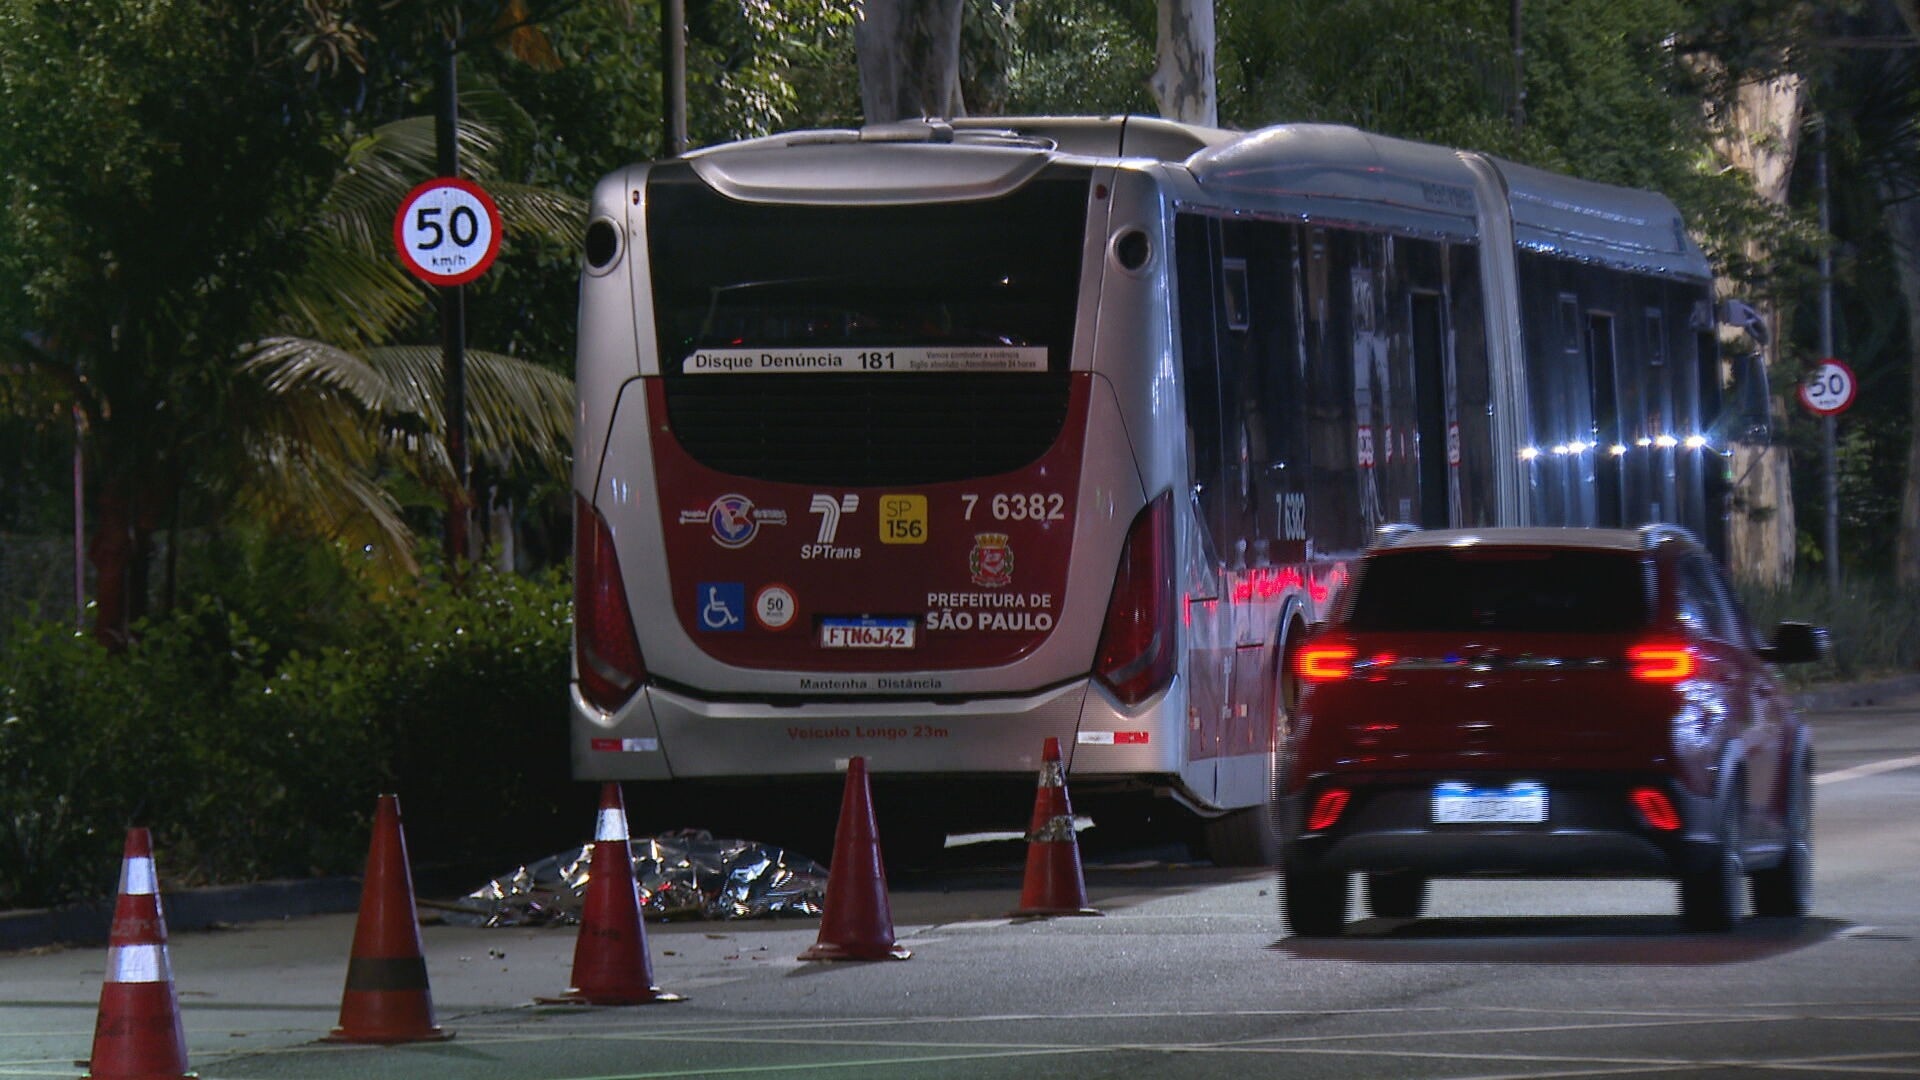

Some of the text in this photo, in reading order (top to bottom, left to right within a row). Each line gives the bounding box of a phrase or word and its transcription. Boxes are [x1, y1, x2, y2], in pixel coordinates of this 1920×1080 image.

[416, 205, 479, 250] 50
[431, 254, 467, 267] km/h
[695, 352, 895, 370] Disque Denúncia 181
[1811, 373, 1844, 397] 50
[886, 500, 912, 517] SP
[961, 493, 1065, 520] 7 6382
[886, 519, 922, 539] 156
[800, 544, 862, 559] SPTrans
[767, 598, 784, 611] 50
[927, 593, 1052, 608] PREFEITURA DE
[926, 608, 1054, 631] SÃO PAULO
[829, 627, 906, 645] FTN6J42
[800, 677, 942, 690] Mantenha Distância
[855, 725, 908, 741] Longo
[913, 724, 949, 738] 23m
